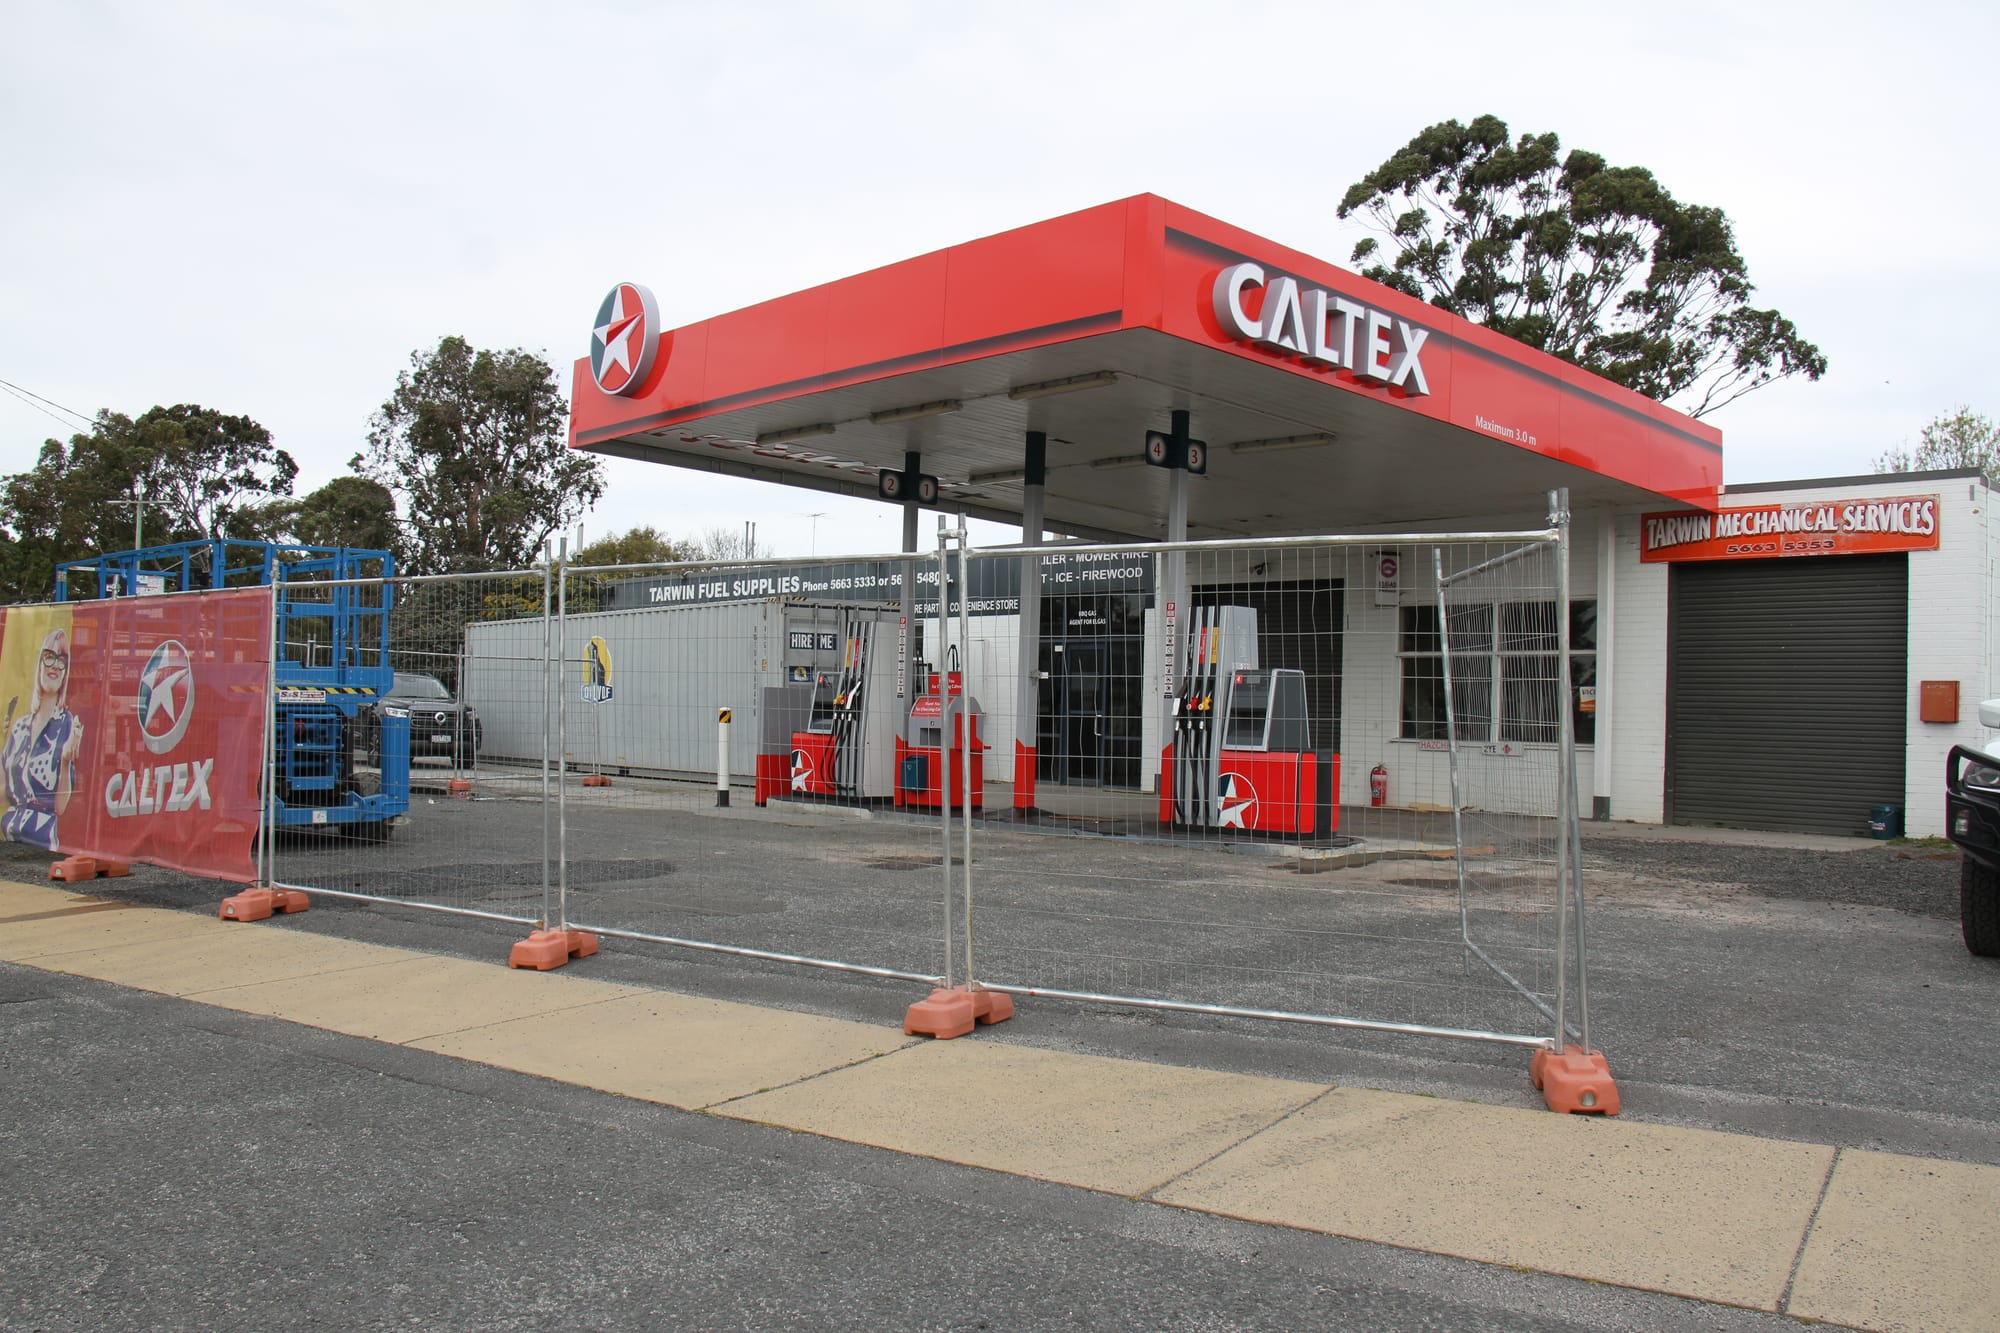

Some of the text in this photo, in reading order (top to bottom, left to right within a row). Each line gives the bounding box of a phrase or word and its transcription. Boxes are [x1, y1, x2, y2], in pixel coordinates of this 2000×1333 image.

[1213, 263, 1430, 396] CALTEX
[1475, 415, 1537, 446] Maximum 3.0 m
[1153, 442, 1161, 457] 4
[1191, 450, 1199, 464] 3
[887, 478, 895, 492] 2
[924, 484, 929, 496] 1
[1647, 500, 1936, 552] TARWIN MECHANICAL SERVICES
[1727, 540, 1836, 554] 5663 5353
[1076, 552, 1119, 563] MOWER
[1122, 551, 1149, 560] HIRE
[1055, 572, 1073, 583] ICE
[1082, 567, 1143, 581] FIREWOOD
[650, 584, 695, 602] TARWIN
[699, 581, 730, 599] FUEL
[733, 575, 800, 597] SUPPLIES
[802, 581, 828, 592] Phone
[830, 577, 851, 590] 5663
[854, 576, 876, 588] 5333
[878, 577, 888, 586] or
[924, 602, 940, 613] PART
[996, 599, 1019, 610] STORE
[791, 633, 833, 649] HIRE ME
[106, 758, 213, 818] CALTEX
